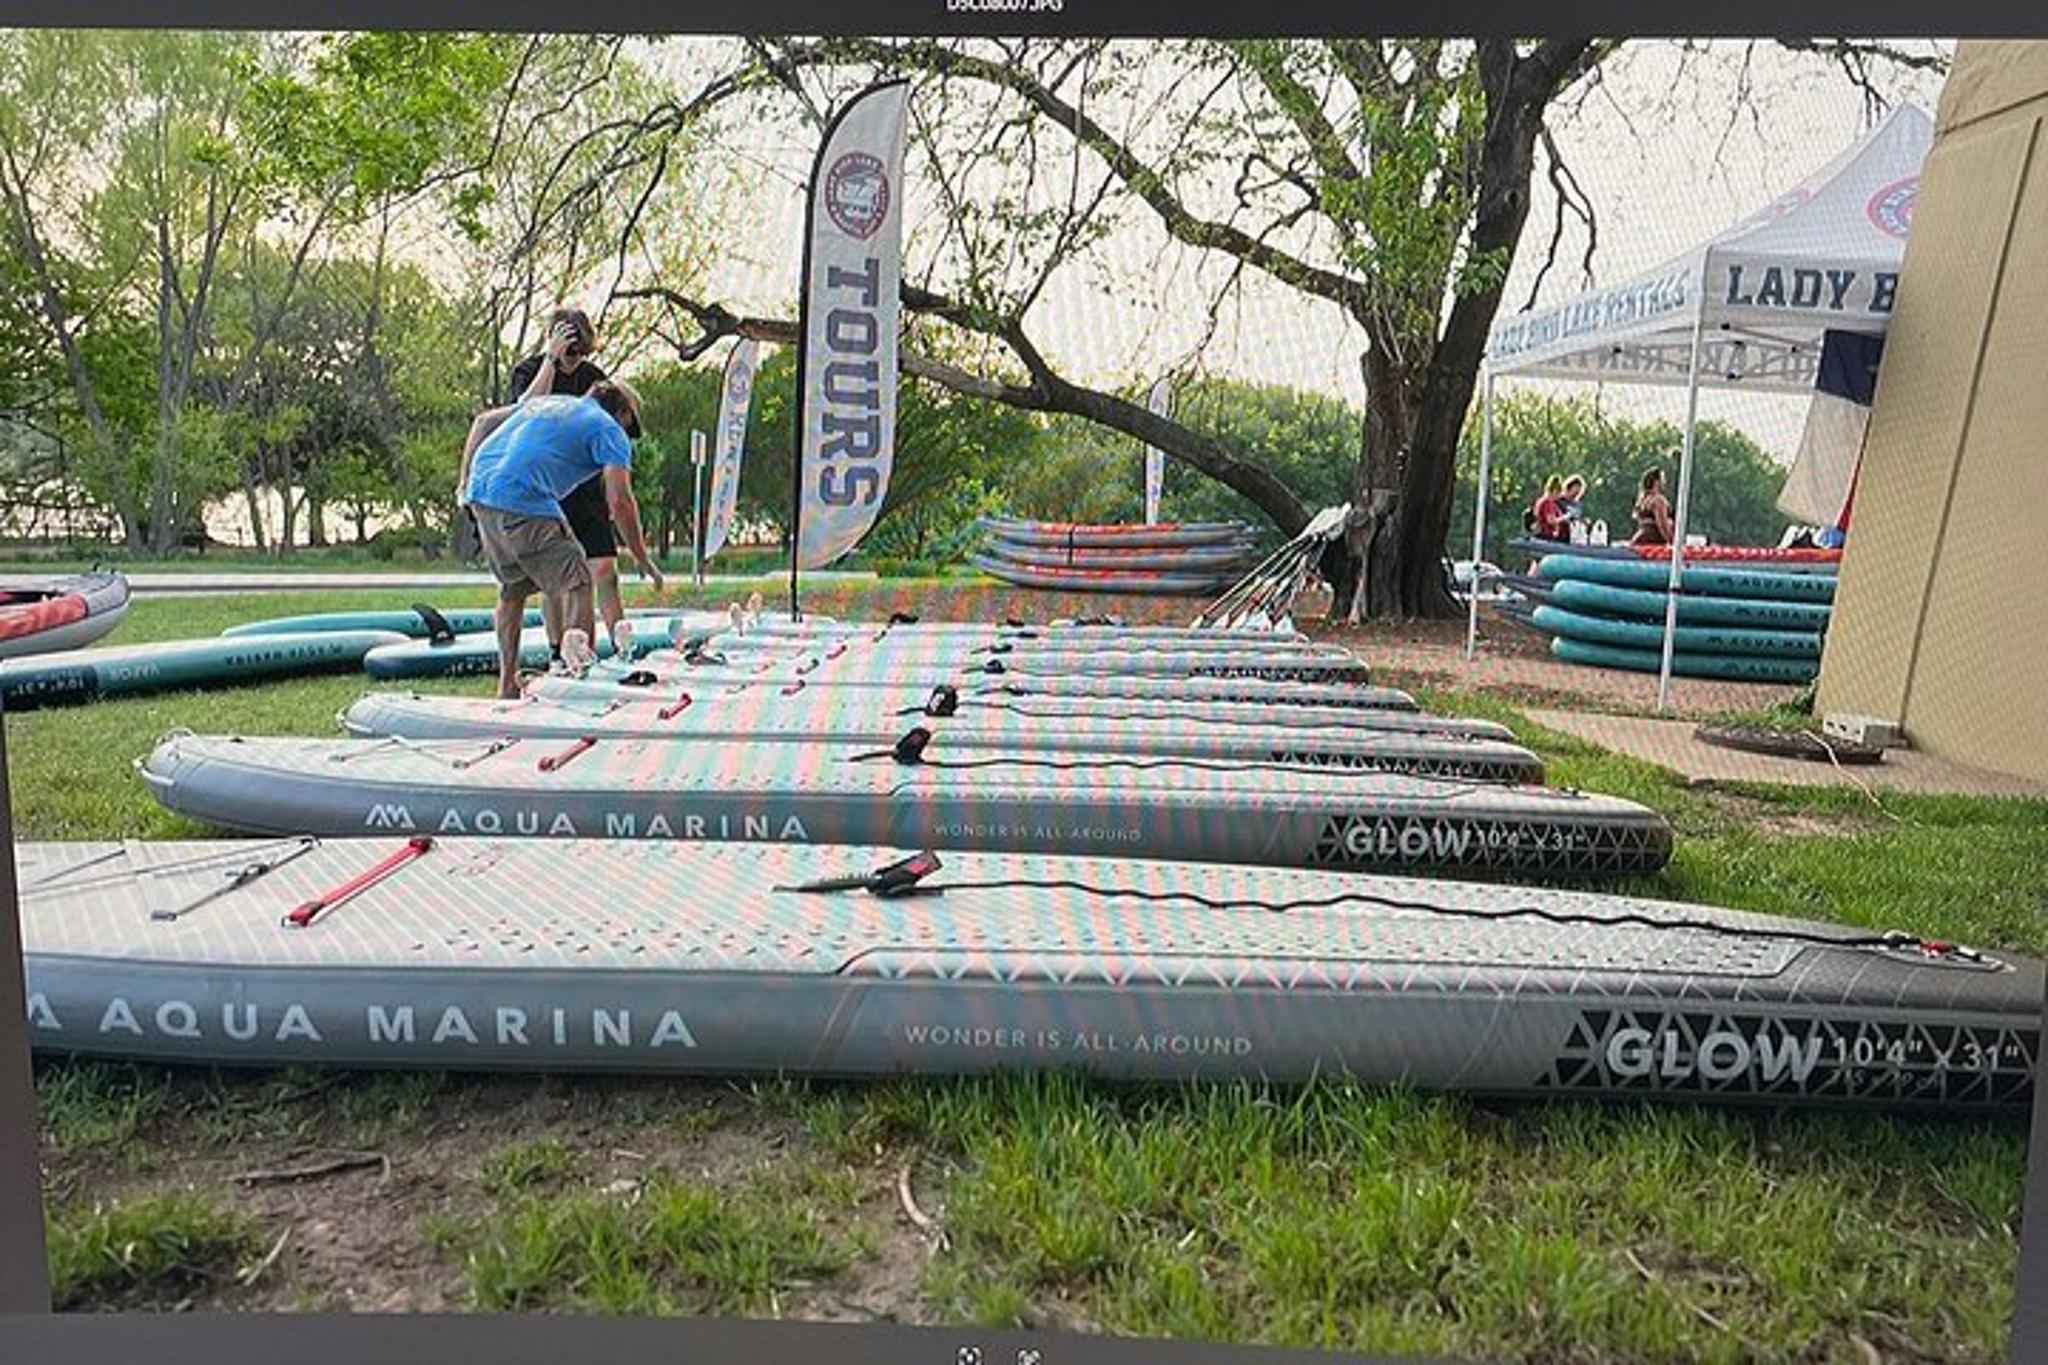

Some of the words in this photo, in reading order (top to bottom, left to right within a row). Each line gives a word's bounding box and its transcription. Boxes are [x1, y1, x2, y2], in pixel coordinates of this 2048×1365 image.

[1726, 264, 1856, 311] LADY
[819, 257, 880, 506] TOURS
[438, 807, 579, 834] AQUA
[605, 811, 809, 840] MARINA
[932, 823, 1009, 837] WONDER
[1013, 824, 1028, 837] IS
[1347, 825, 1472, 857] GLOW
[99, 997, 322, 1042] AQUA
[368, 1004, 698, 1048] MARINA
[904, 1025, 1026, 1049] WONDER
[1036, 1029, 1061, 1050] IS
[1606, 1027, 1824, 1082] GLOW
[1833, 1037, 1923, 1067] 10'4"
[1963, 1043, 2019, 1072] 31"
